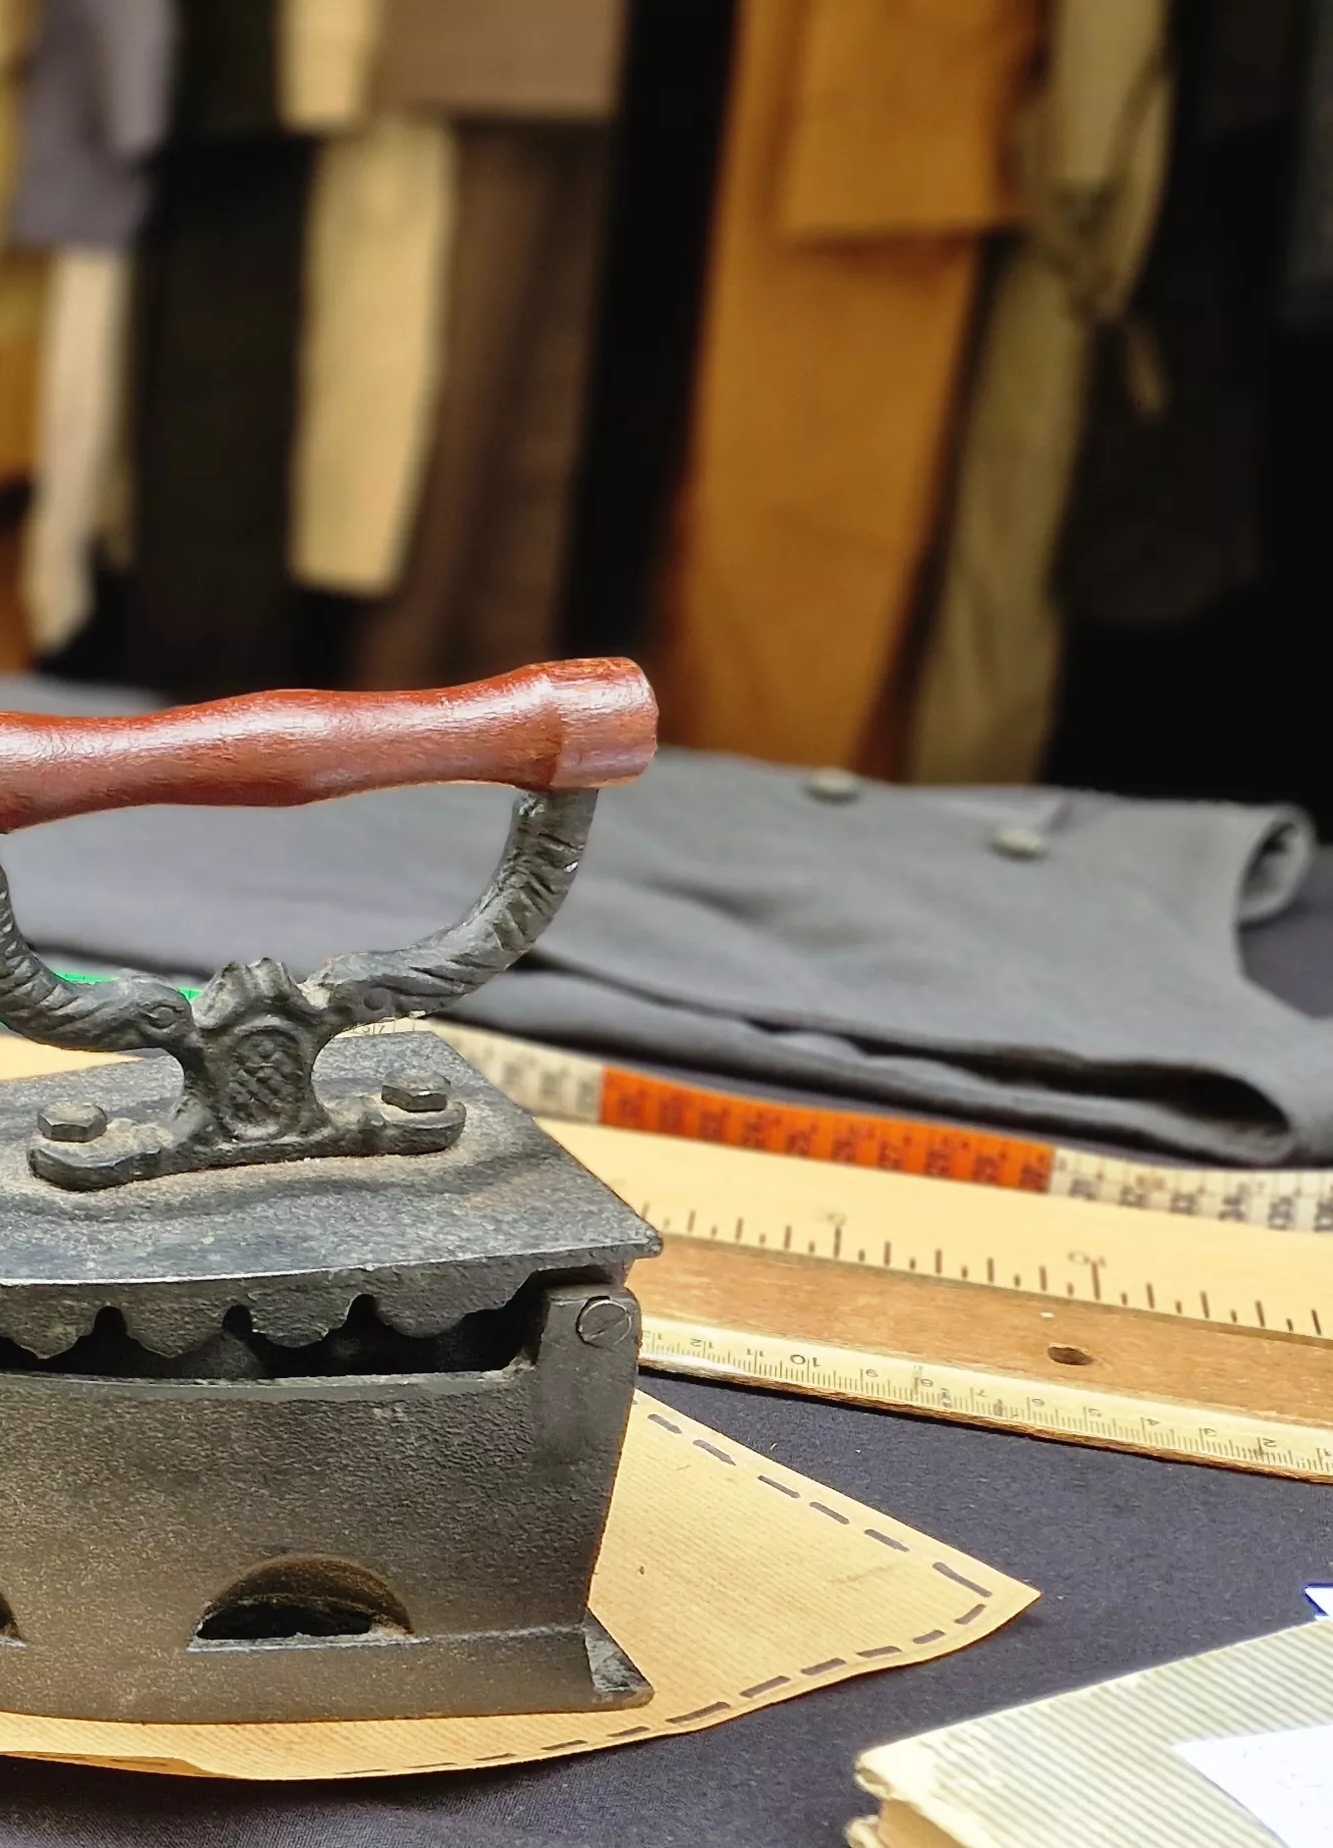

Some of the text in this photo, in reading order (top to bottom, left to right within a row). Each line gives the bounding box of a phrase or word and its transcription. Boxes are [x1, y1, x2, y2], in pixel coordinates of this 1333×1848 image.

[690, 1337, 715, 1350] 12
[746, 1347, 765, 1358] 11
[789, 1353, 822, 1368] 10
[865, 1368, 879, 1378] 9
[920, 1377, 934, 1387] 8
[975, 1389, 986, 1398] 7
[1032, 1398, 1046, 1407] 6
[1088, 1408, 1103, 1418] 5
[1145, 1417, 1160, 1426] 4
[1203, 1427, 1218, 1437] 3
[1262, 1438, 1278, 1448] 2
